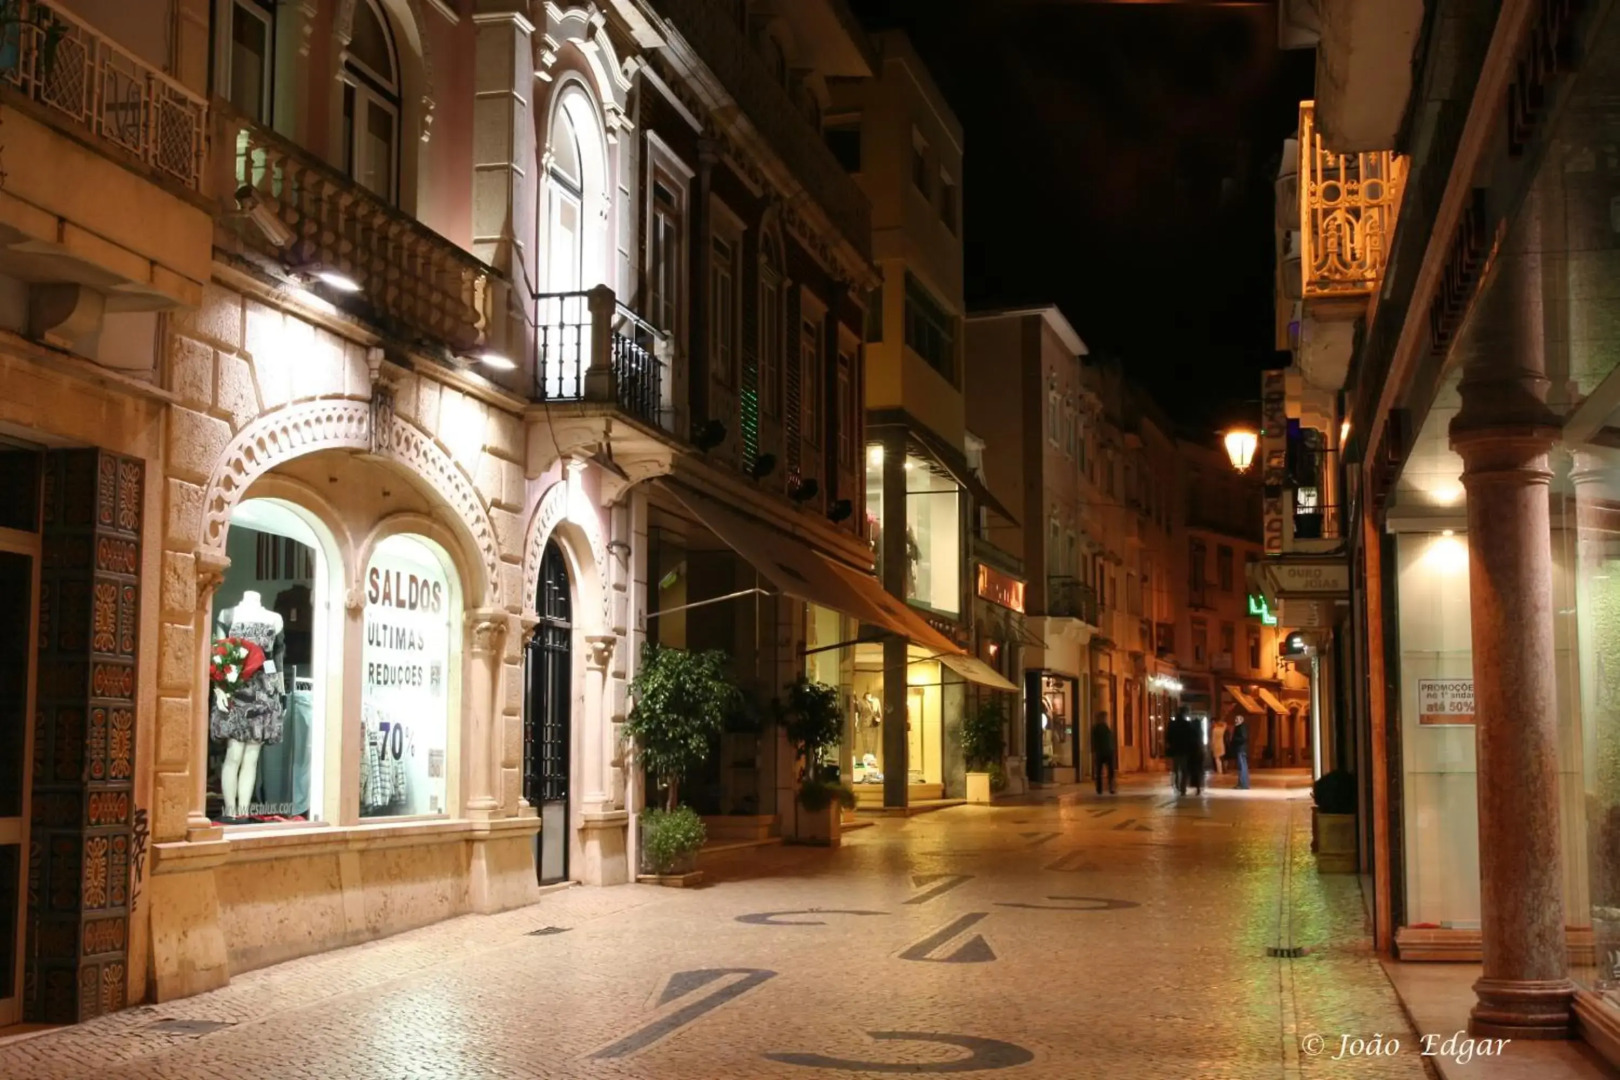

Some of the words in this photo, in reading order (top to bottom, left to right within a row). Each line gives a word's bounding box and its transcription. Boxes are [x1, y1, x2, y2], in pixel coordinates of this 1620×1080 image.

[368, 566, 442, 614] SALDOS
[1421, 683, 1475, 693] PROMOÇÕE
[1426, 701, 1446, 712] até
